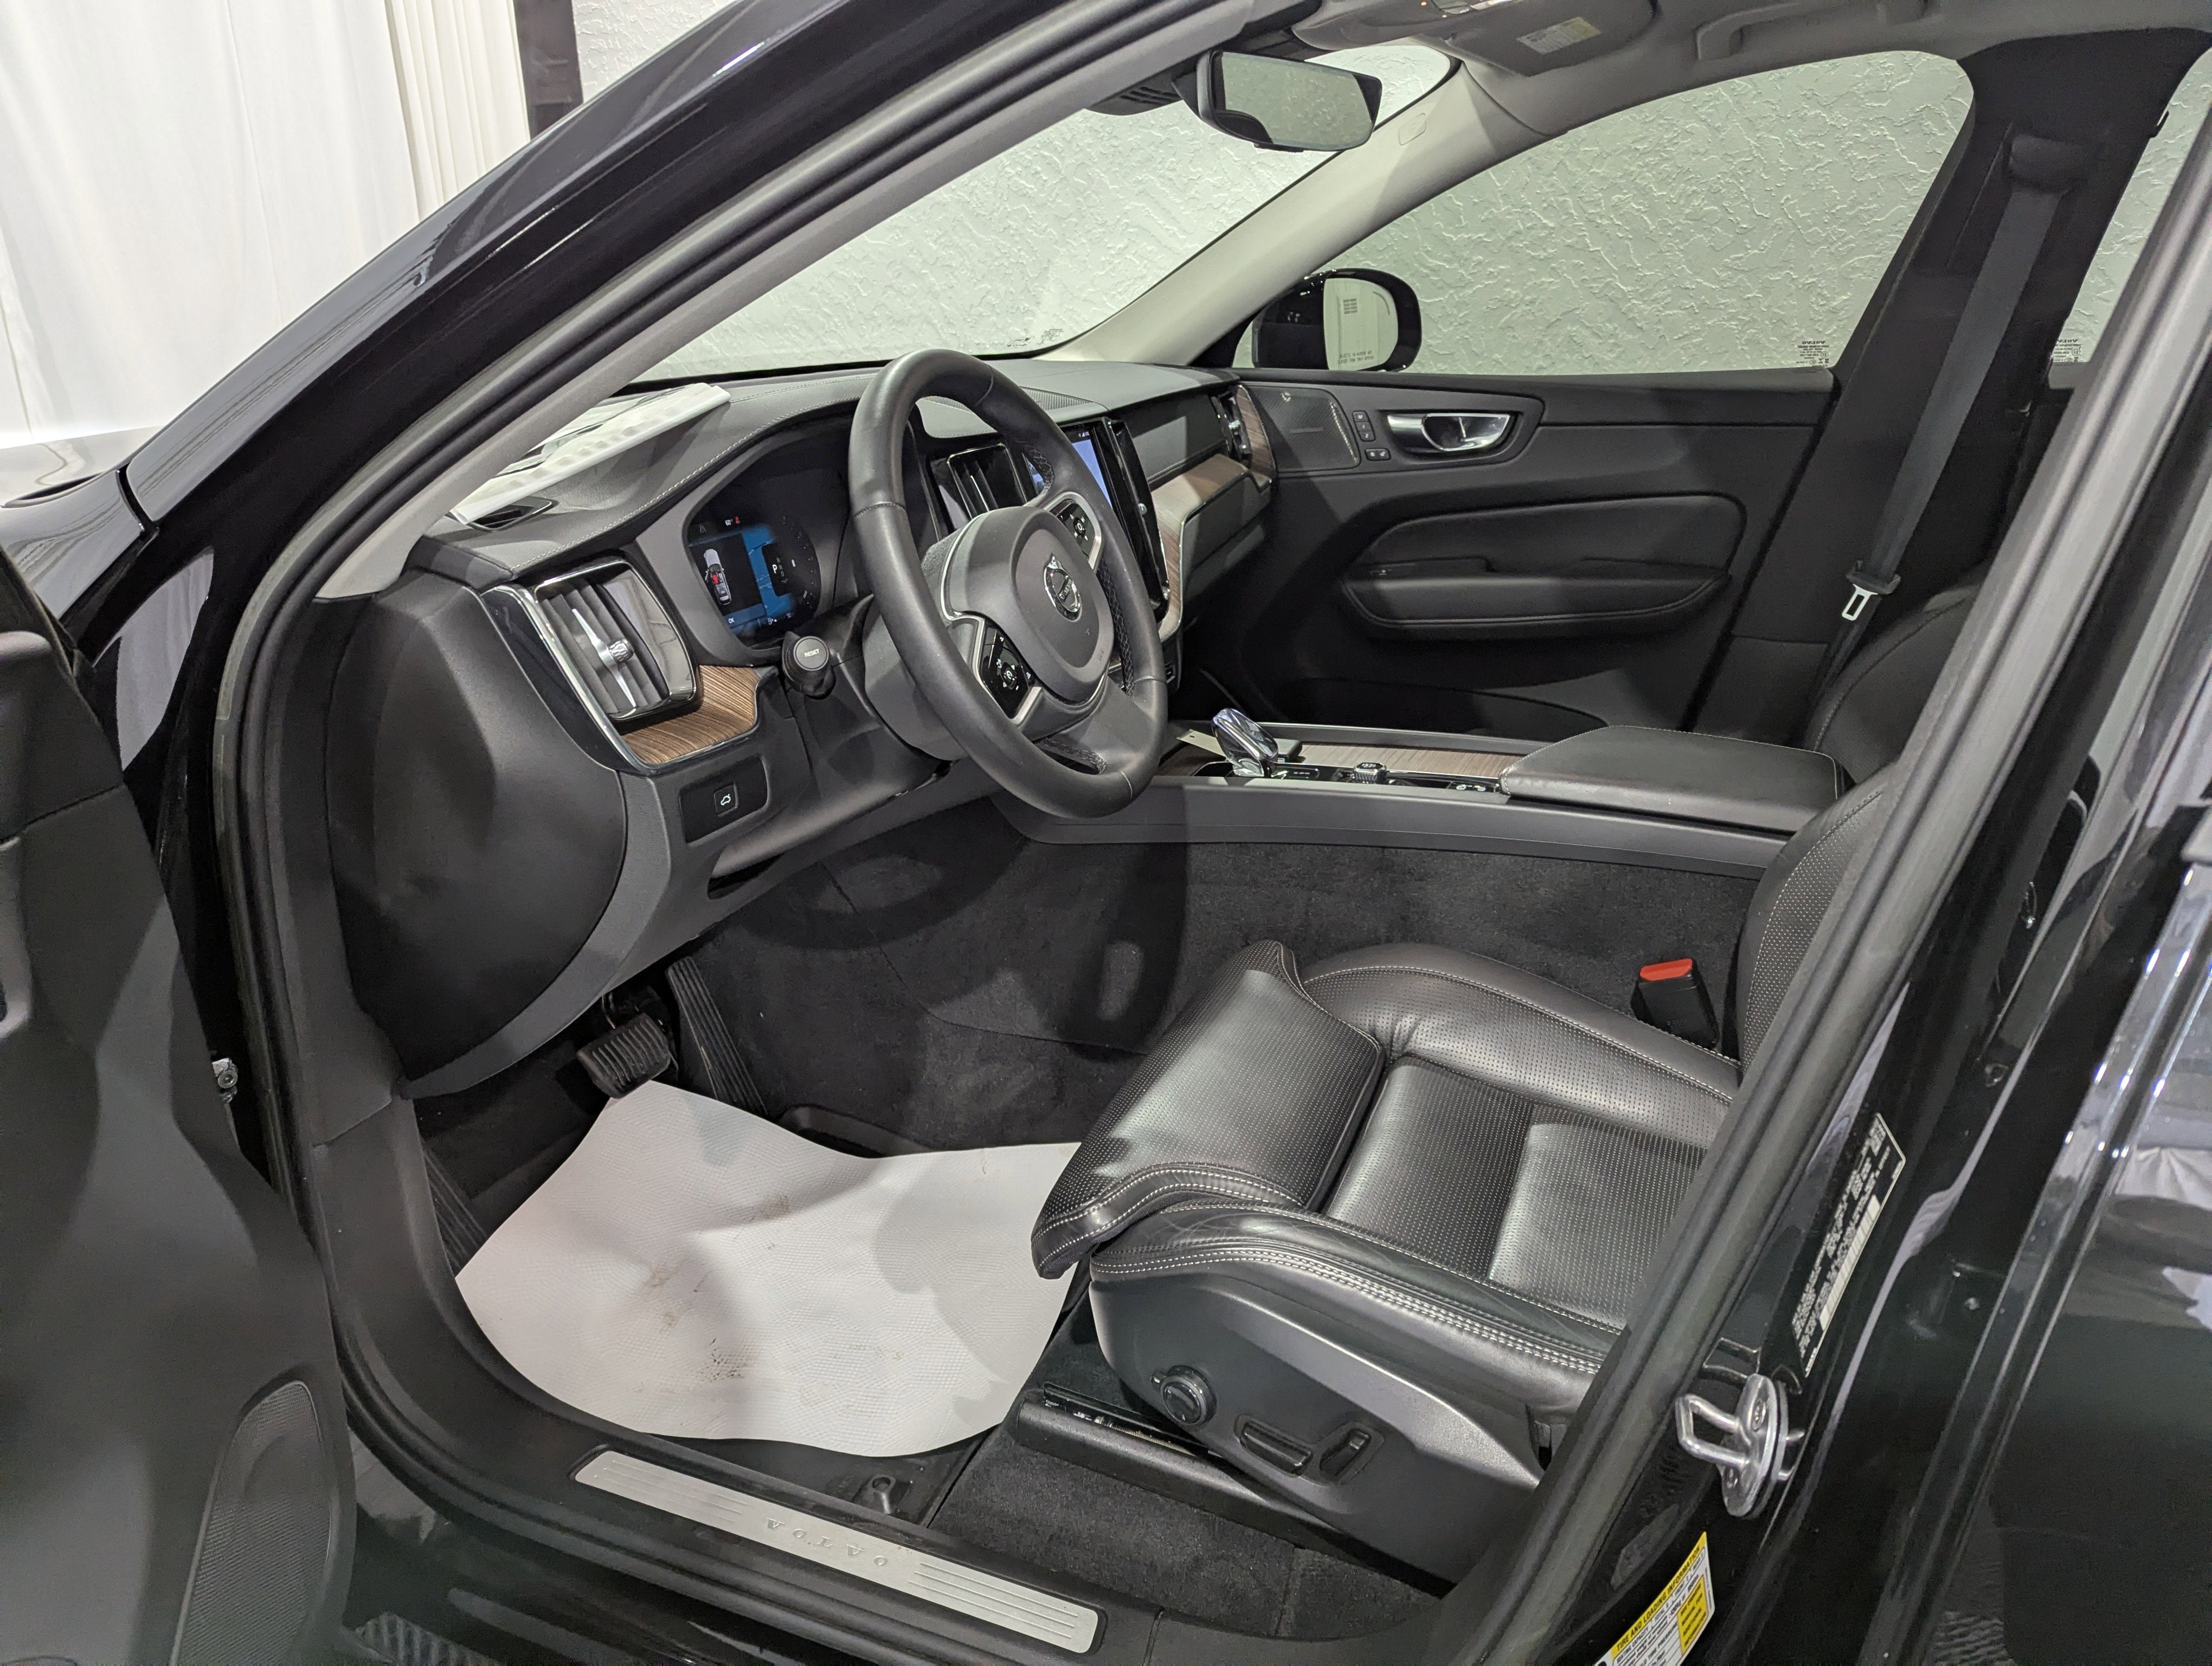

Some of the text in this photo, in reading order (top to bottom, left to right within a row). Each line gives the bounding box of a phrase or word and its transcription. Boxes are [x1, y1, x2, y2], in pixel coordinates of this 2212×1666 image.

[772, 564, 777, 574] P
[803, 648, 820, 658] RESET
[767, 1517, 889, 1566] VOLVO
[1616, 1636, 1630, 1651] TIRE
[1630, 1622, 1642, 1636] AND
[1643, 1593, 1667, 1622] LOADING
[1667, 1546, 1700, 1595] INFORMATION
